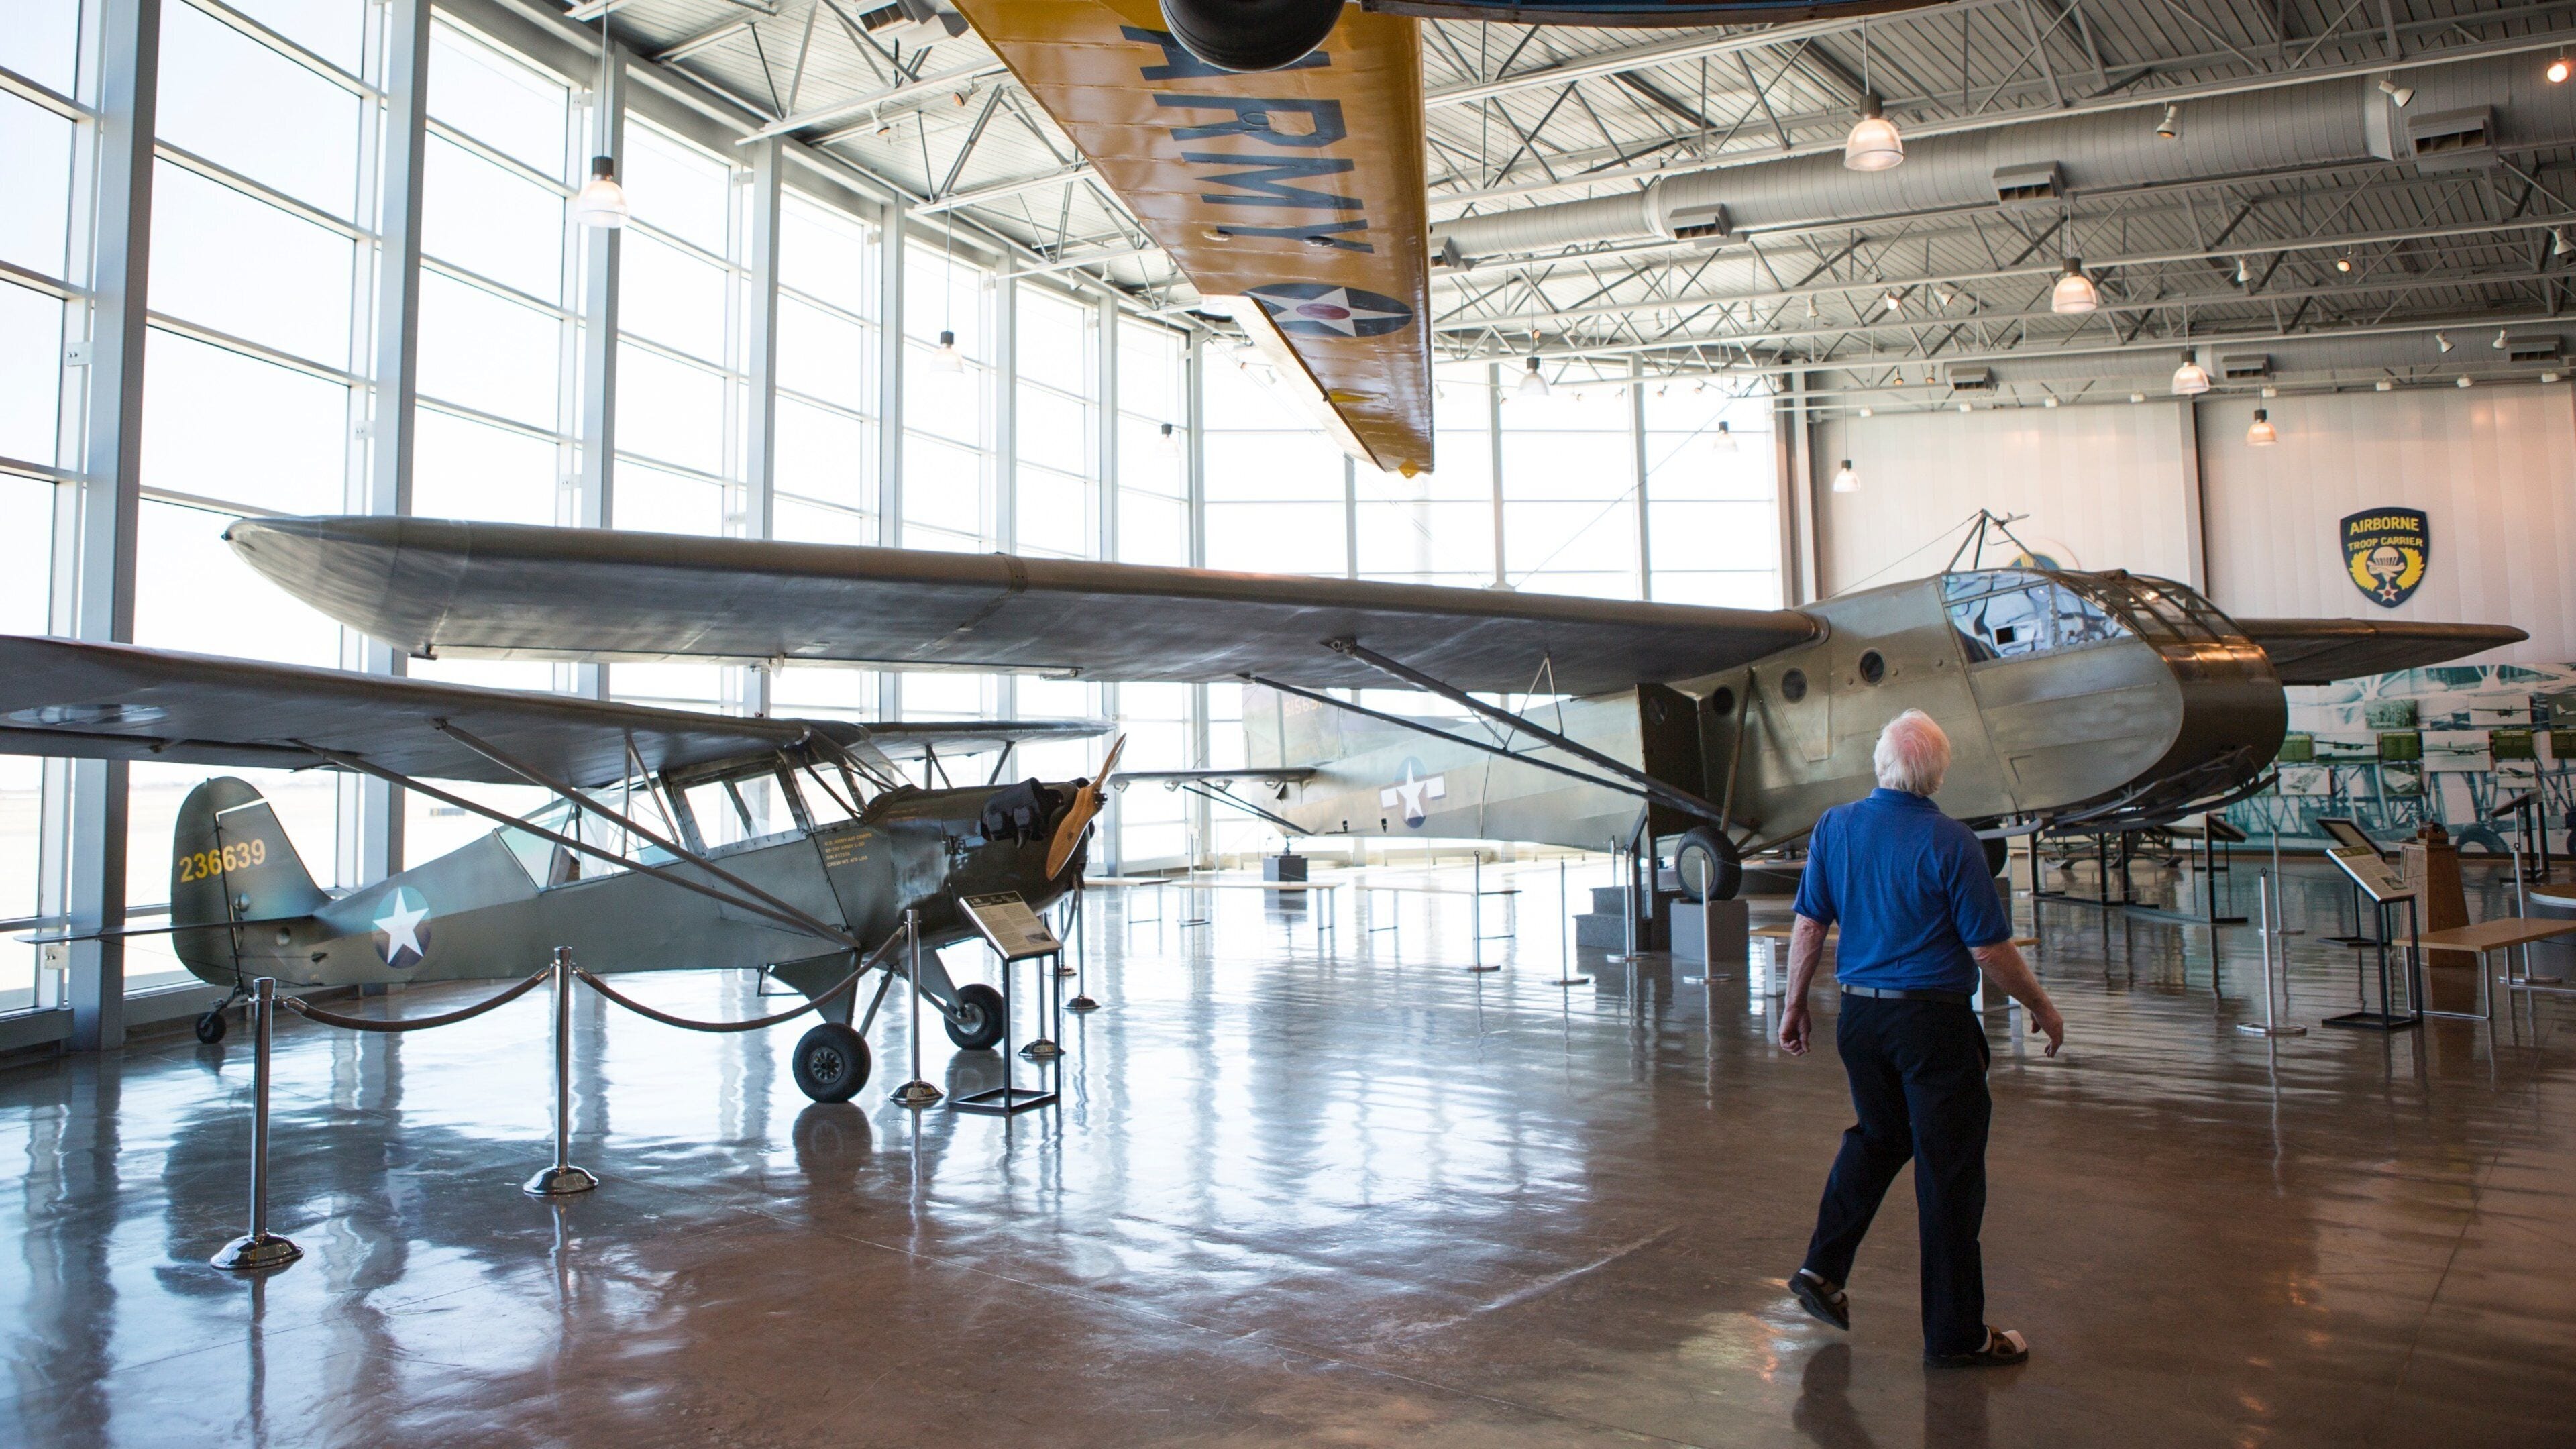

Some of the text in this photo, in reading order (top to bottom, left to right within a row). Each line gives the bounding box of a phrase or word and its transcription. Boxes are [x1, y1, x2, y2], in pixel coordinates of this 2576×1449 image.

[2349, 516, 2420, 536] AIRBORNE
[2347, 536, 2423, 551] TROOP CARRIER
[178, 839, 266, 883] 236639
